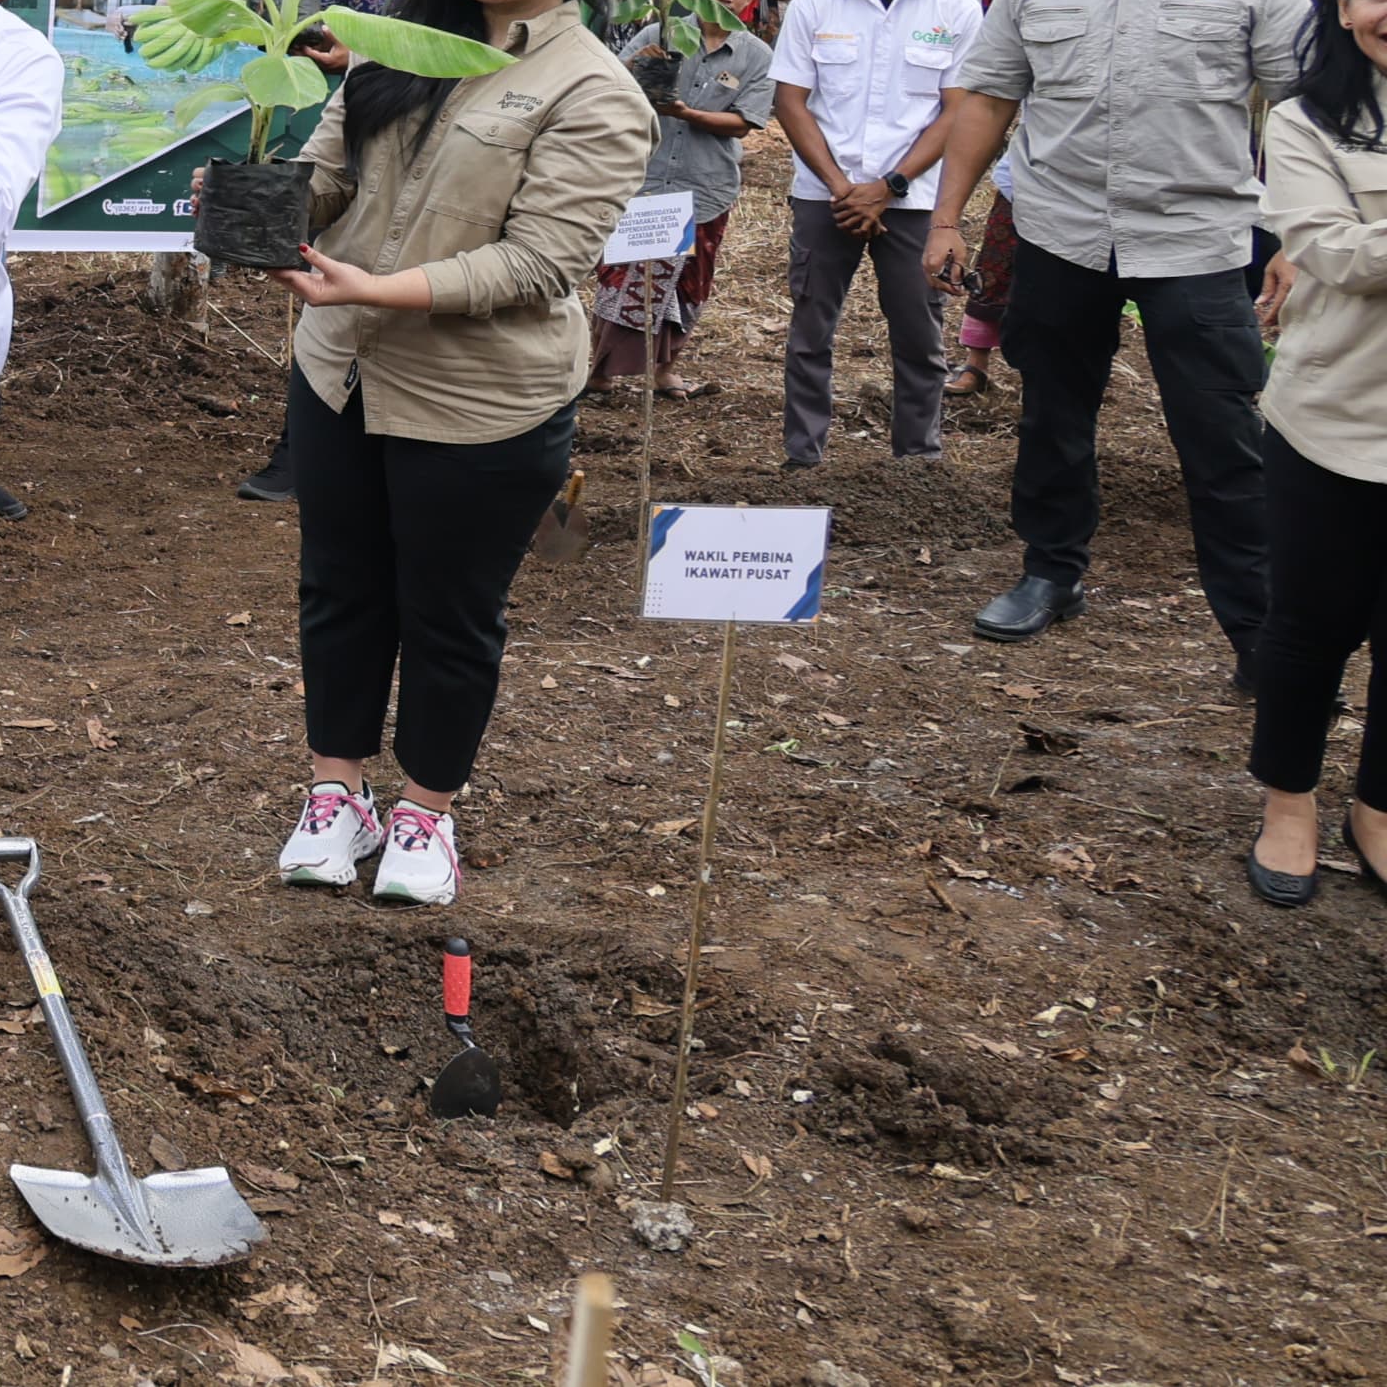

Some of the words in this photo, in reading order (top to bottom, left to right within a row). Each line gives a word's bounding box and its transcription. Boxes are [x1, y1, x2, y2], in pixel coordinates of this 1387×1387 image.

[505, 90, 545, 107] Reforma
[684, 550, 728, 562] WAKIL
[732, 551, 794, 564] PEMBINA
[684, 567, 743, 580] IKAWATI
[746, 568, 791, 580] PUSAT
